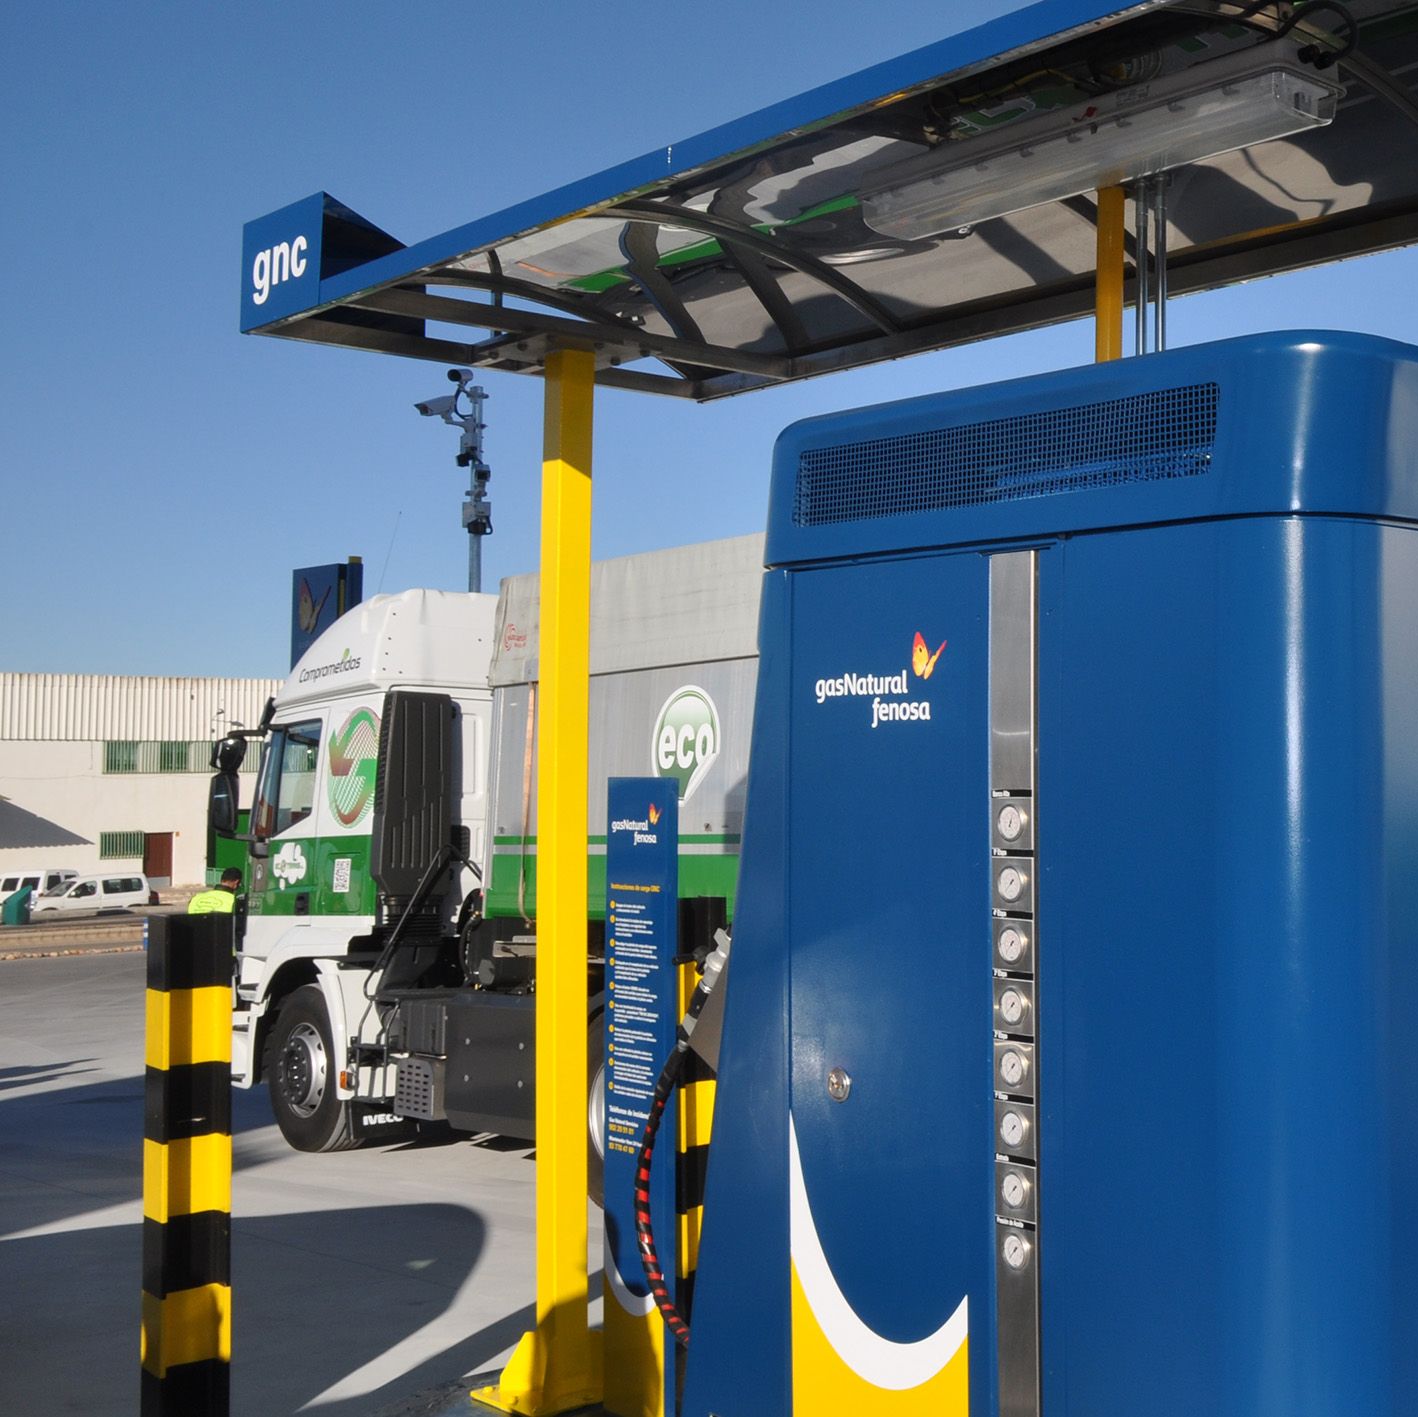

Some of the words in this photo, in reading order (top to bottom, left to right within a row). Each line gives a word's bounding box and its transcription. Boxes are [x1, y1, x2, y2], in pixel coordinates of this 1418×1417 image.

[253, 235, 307, 305] gnc
[299, 657, 361, 683] Comprometidos
[815, 669, 909, 704] gasNatural
[871, 697, 931, 728] fenosa
[658, 723, 714, 770] eco
[611, 819, 649, 833] gasNatural
[633, 831, 657, 846] fenosa
